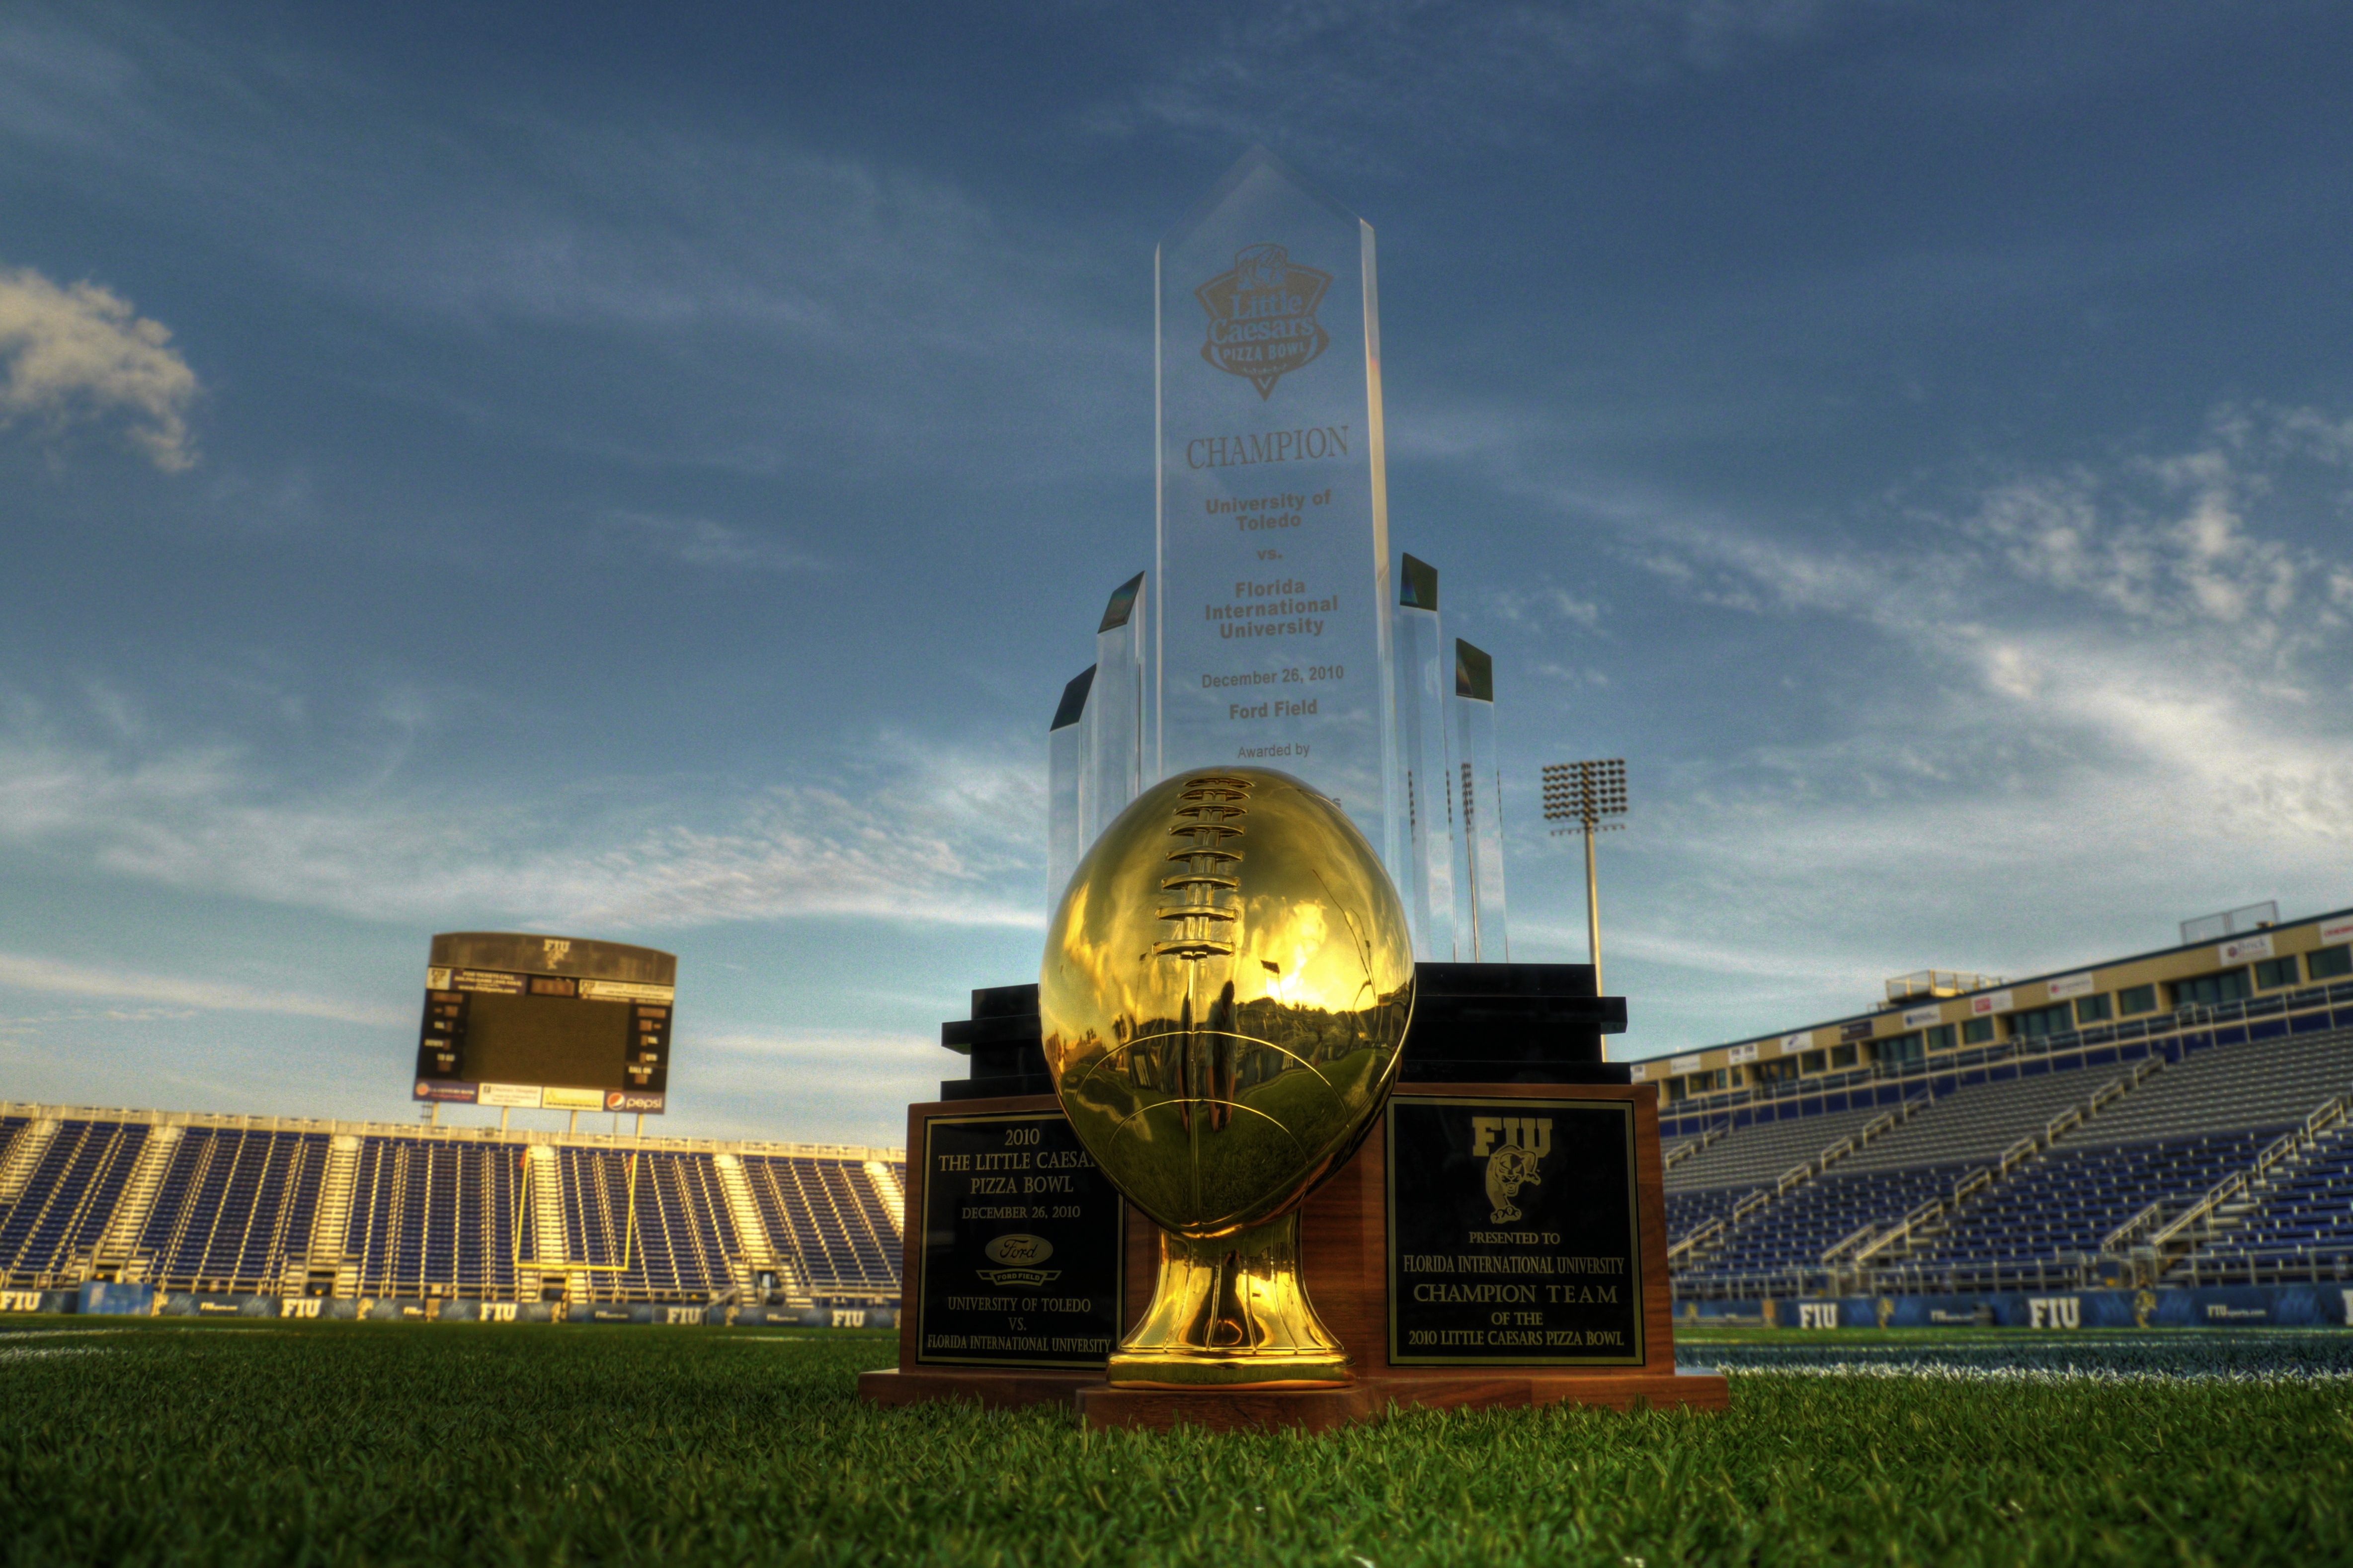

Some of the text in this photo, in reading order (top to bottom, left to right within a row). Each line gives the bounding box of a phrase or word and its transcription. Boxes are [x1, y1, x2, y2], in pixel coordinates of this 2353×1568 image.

[1231, 289, 1302, 321] Little
[1210, 316, 1315, 344] Caesars
[1222, 341, 1305, 361] PIZZA BOWL
[1186, 425, 1348, 469] CHAMPION
[1206, 489, 1331, 515] University of
[1235, 512, 1301, 531] Toledo
[1257, 549, 1282, 561] vs.
[1235, 578, 1305, 597] Florida
[1205, 596, 1338, 620] International
[1220, 618, 1324, 639] University
[1202, 665, 1344, 688] December 26, 2010
[1229, 699, 1318, 719] Ford Field
[1238, 743, 1310, 758] Awarded by
[544, 939, 570, 952] FIU
[626, 1097, 662, 1109] pepsi
[1005, 1128, 1040, 1146] 2010
[1472, 1116, 1552, 1158] FIU
[939, 1151, 1095, 1171] THE LITTLE CAESA
[971, 1176, 1073, 1194] PIZZA BOWL
[962, 1206, 1080, 1219] DECEMBER 26, 2010
[1468, 1232, 1560, 1244] PRESENTED TO
[1000, 1239, 1038, 1259] Ford
[1404, 1255, 1624, 1274] FLORIDA INTERNATIONAL UNIVERSITY
[997, 1273, 1040, 1282] FORD FIELD
[0, 1292, 41, 1311] FIU
[1414, 1284, 1618, 1304] CHAMPION TEAM
[282, 1299, 322, 1318] FIU
[481, 1303, 517, 1321] FIU
[948, 1297, 1091, 1313] UNIVERSITY OF TOLEDO
[2028, 1297, 2080, 1329] FIU
[667, 1307, 701, 1324] FIU
[832, 1310, 865, 1327] FIU
[1008, 1318, 1027, 1331] VS.
[1491, 1312, 1543, 1325] OF THE
[1799, 1303, 1838, 1329] FIU
[928, 1334, 1111, 1353] FLORIDA INTERNATIONAL UNIVERSITY
[1409, 1331, 1624, 1346] 2010 LITTLE CAESARS PIZZA BOWL
